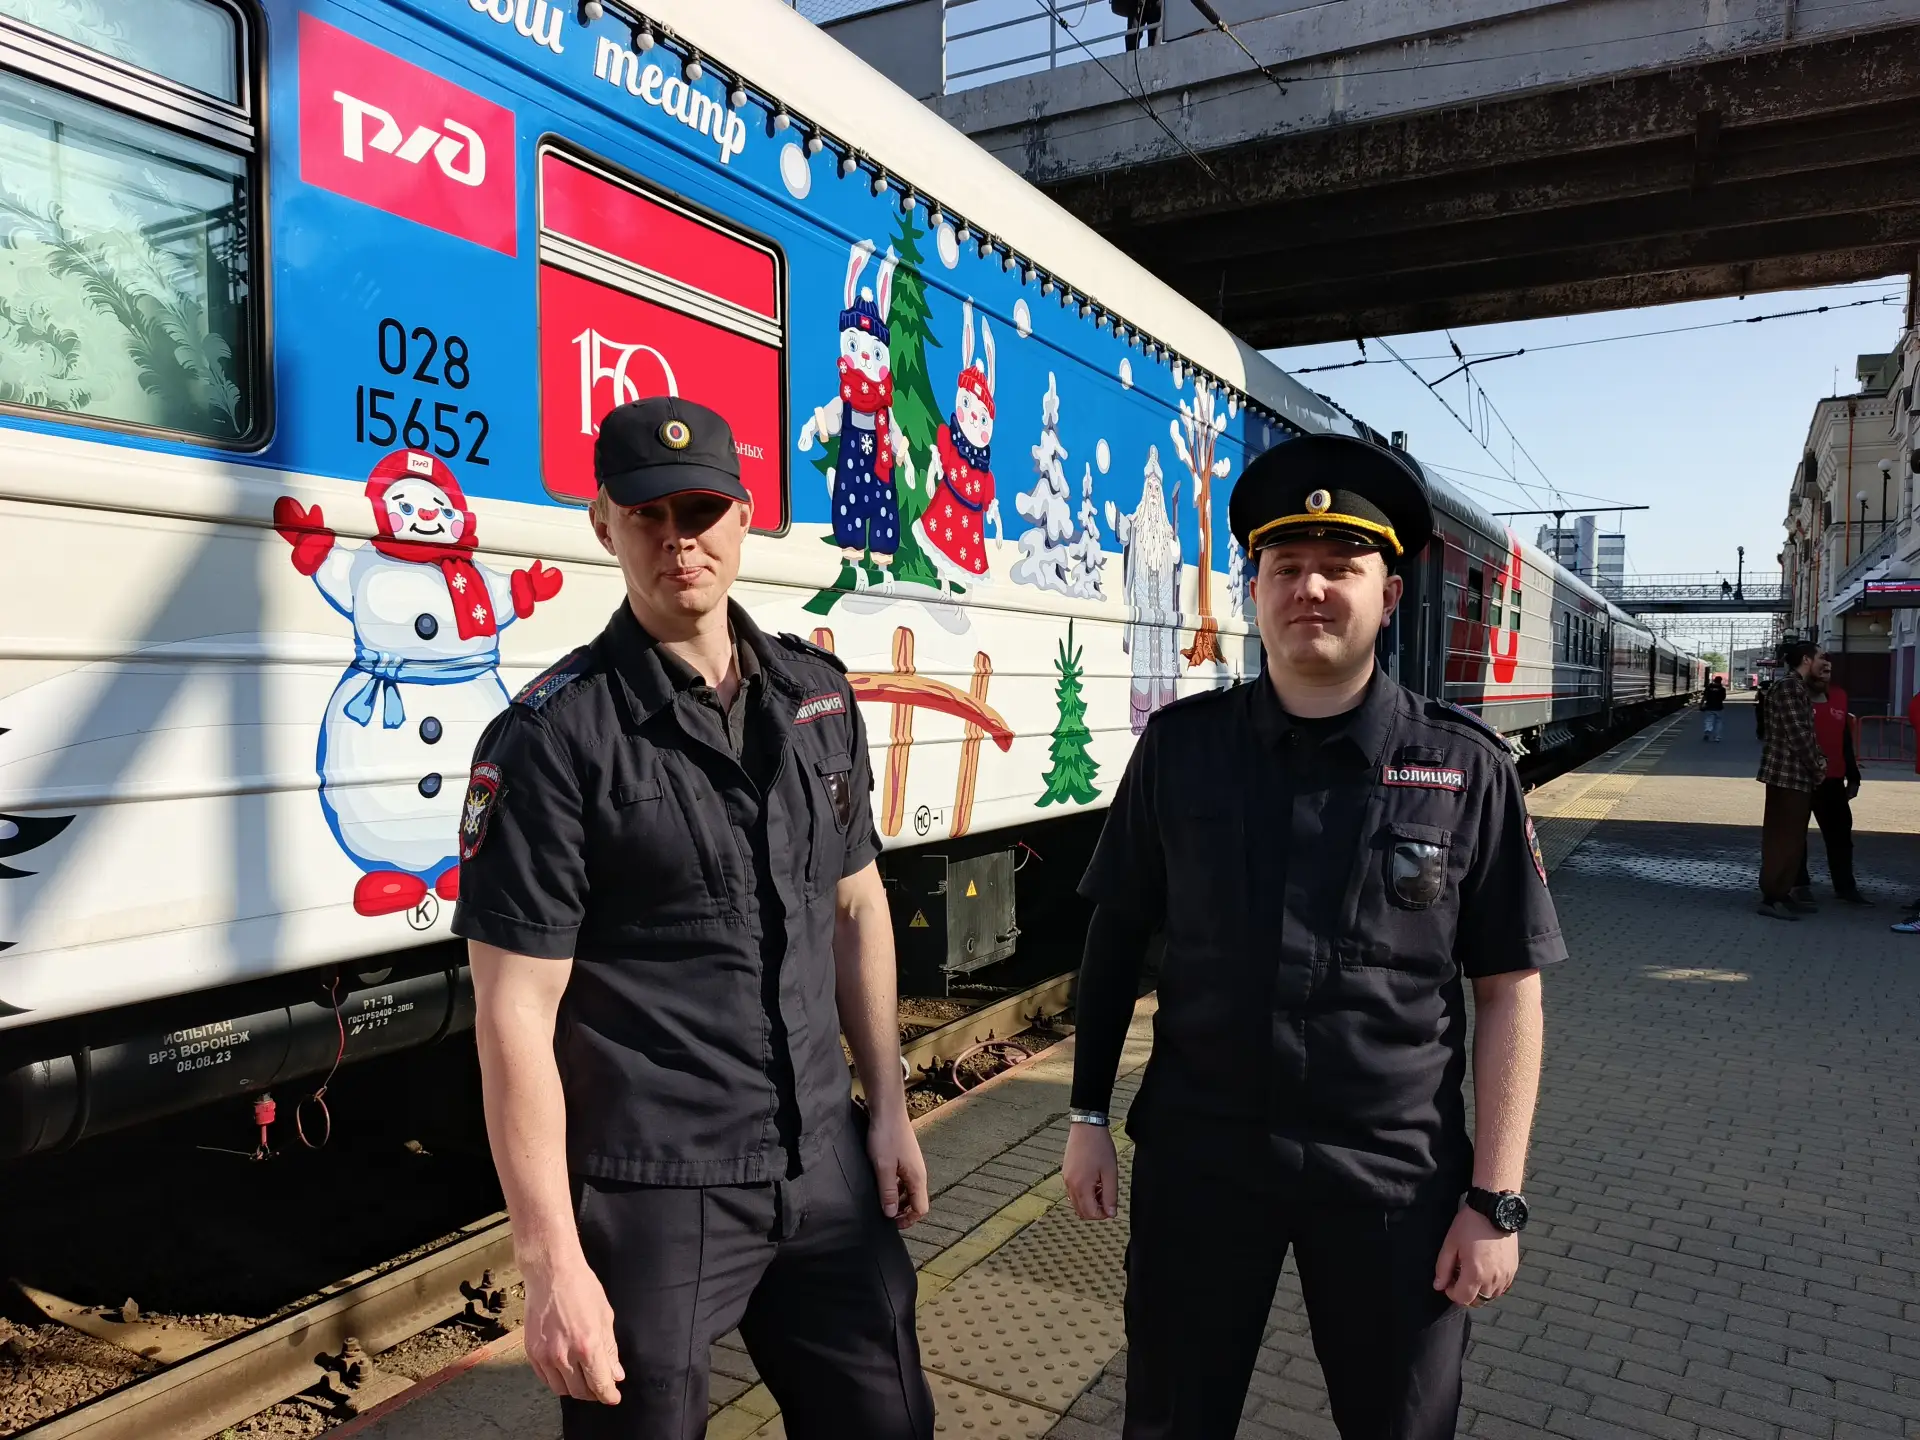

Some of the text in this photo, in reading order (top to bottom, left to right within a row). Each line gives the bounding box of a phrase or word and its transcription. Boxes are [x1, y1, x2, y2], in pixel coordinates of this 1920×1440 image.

[594, 36, 746, 164] театр
[378, 317, 470, 390] 028
[356, 384, 490, 467] 15652
[796, 696, 843, 719] ОЛИЦИЯ
[1387, 769, 1464, 786] ПОЛИЦИЯ
[163, 1019, 233, 1046] ИСПЫТАН
[180, 1030, 251, 1058] ВОРОНЕЖ
[176, 1050, 232, 1073] 08.08.23
